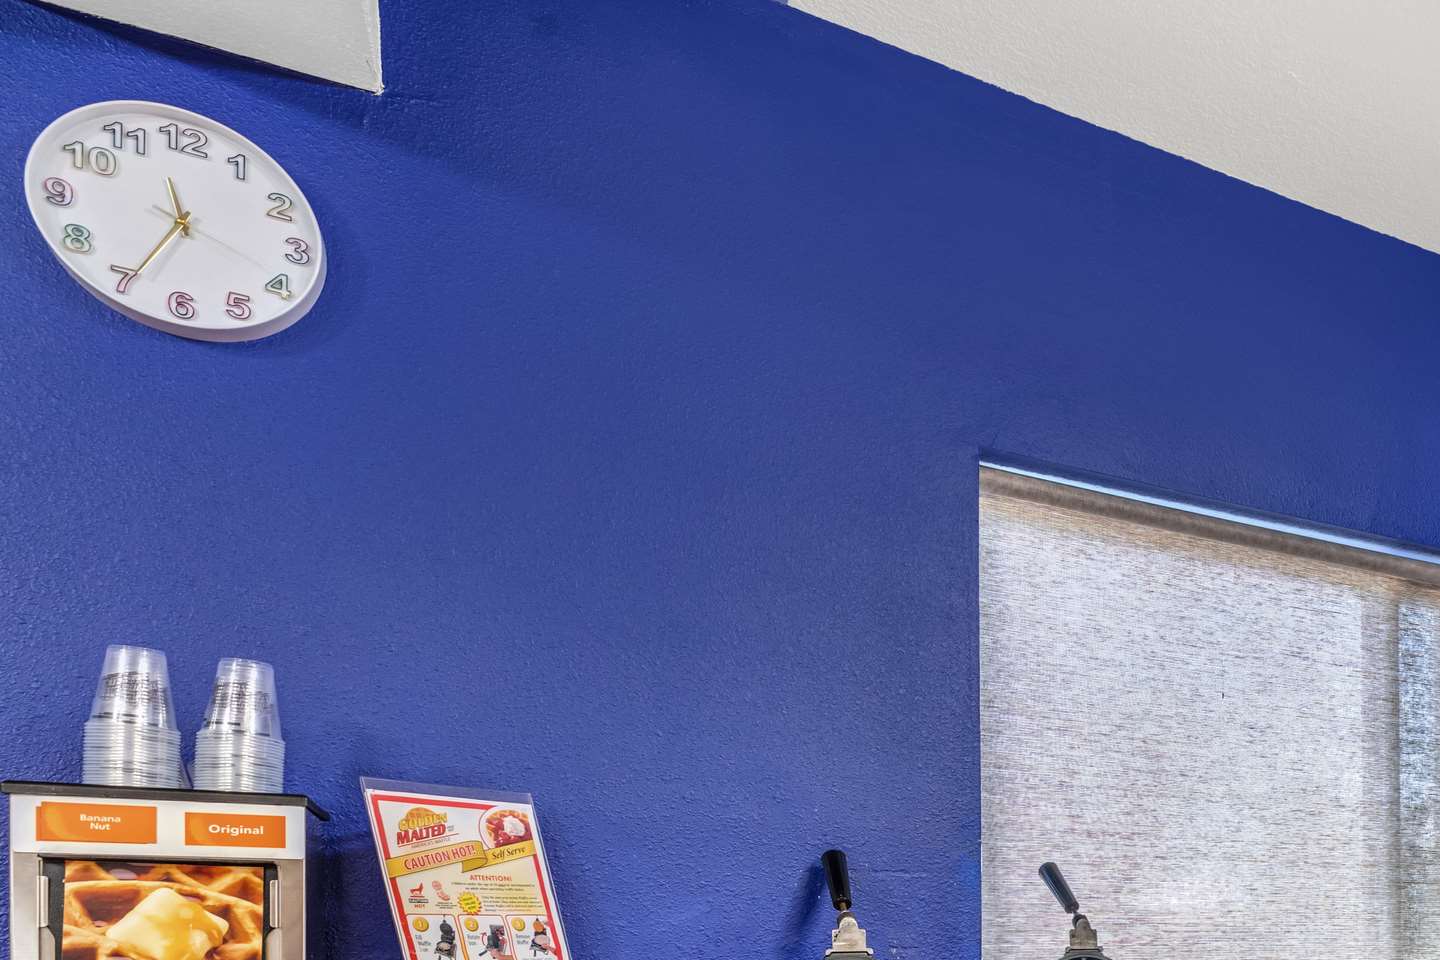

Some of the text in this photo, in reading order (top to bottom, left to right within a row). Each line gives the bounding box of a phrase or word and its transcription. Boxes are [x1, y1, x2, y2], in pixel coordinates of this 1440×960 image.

[103, 121, 147, 156] 11
[159, 122, 209, 159] 12
[64, 140, 117, 176] 10
[227, 153, 247, 181] 1
[44, 176, 74, 207] 9
[266, 192, 293, 222] 2
[62, 223, 92, 254] 8
[285, 237, 310, 265] 3
[110, 264, 140, 293] 7
[265, 273, 292, 300] 4
[167, 291, 195, 320] 6
[226, 291, 251, 320] 5
[79, 813, 121, 823] Banana
[89, 822, 111, 831] Nut
[208, 824, 264, 836] Original
[397, 823, 447, 845] MALTED
[404, 844, 476, 871] CAUTION HOT!
[492, 847, 526, 860] Self Serve
[469, 874, 513, 882] ATTENTION!
